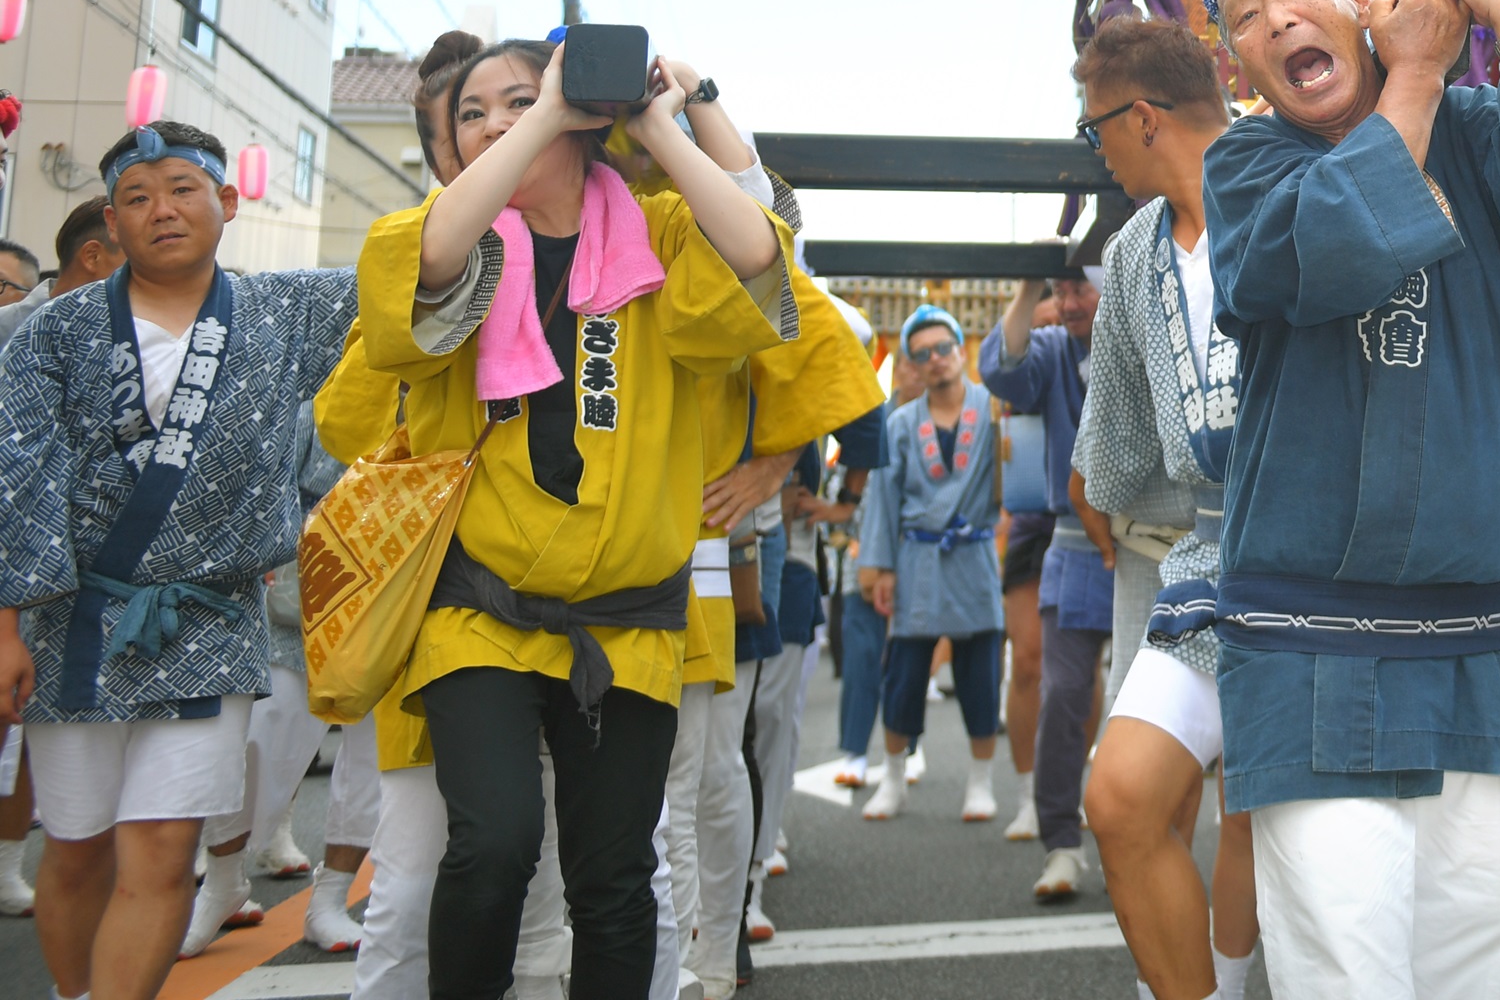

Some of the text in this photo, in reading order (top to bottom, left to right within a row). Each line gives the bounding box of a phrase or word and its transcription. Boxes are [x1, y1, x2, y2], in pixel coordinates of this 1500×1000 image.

[153, 316, 229, 470] 吉田神社
[580, 310, 619, 433] ざま睦
